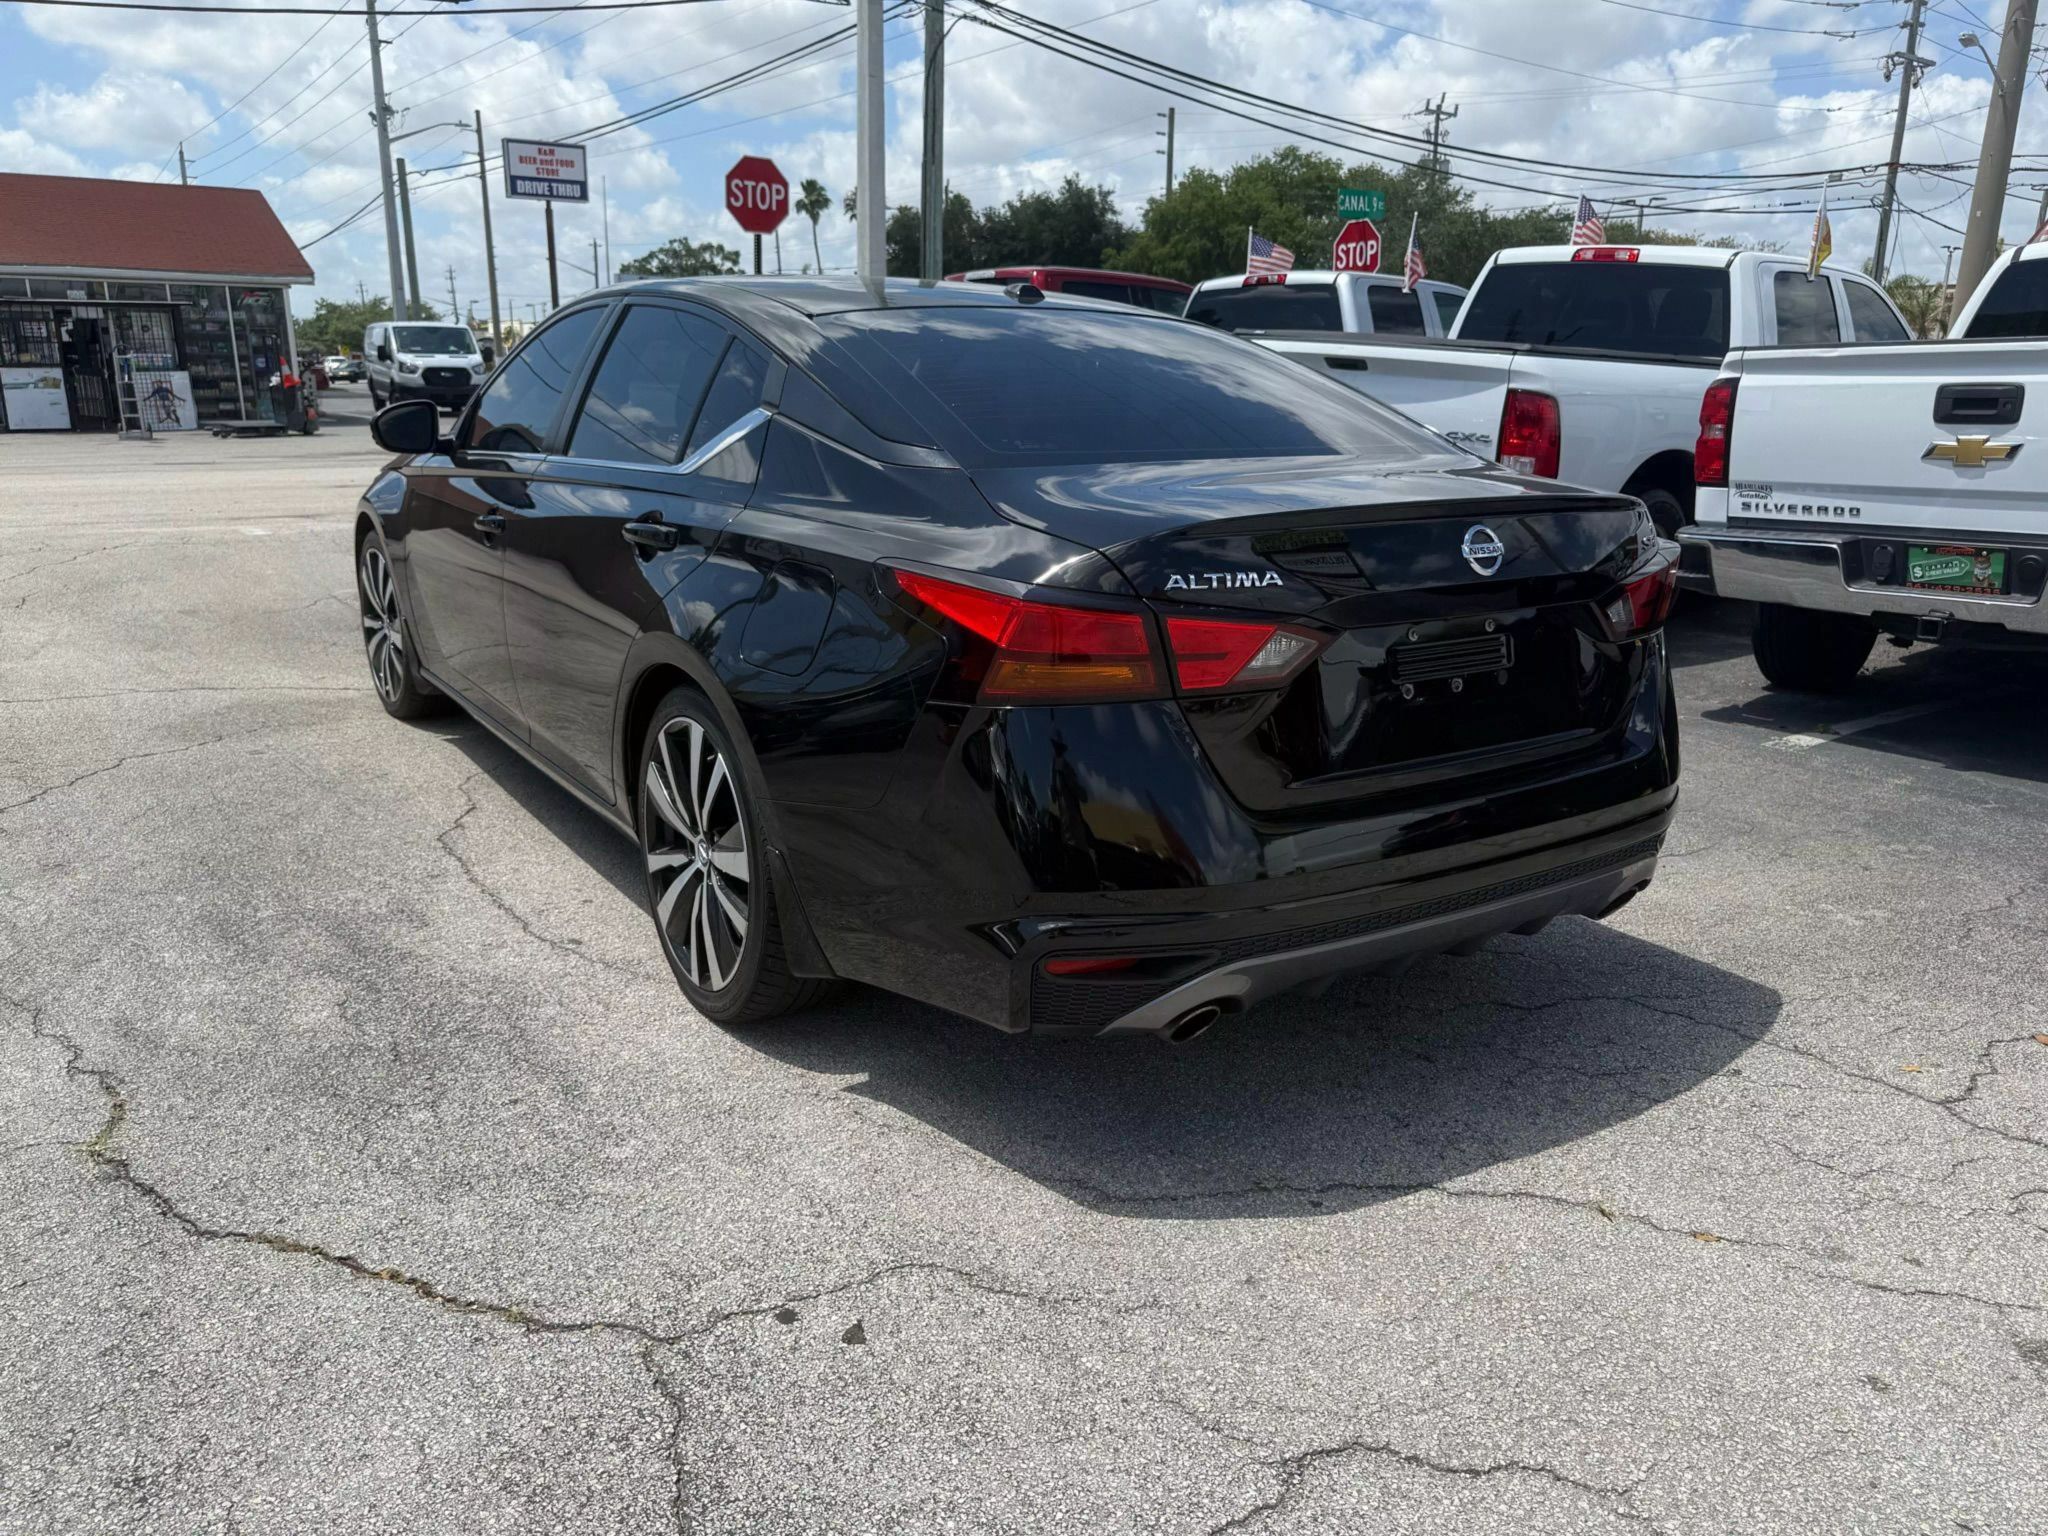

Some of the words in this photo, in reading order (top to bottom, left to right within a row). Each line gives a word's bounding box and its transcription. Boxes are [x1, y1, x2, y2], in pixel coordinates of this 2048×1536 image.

[518, 155, 538, 165] BEER
[555, 159, 576, 169] FOOD
[535, 167, 561, 177] STORE
[516, 179, 551, 195] DRIVE
[551, 183, 581, 198] THRU
[730, 178, 786, 211] STOP
[1338, 195, 1370, 212] CANAL
[1336, 240, 1377, 269] STOP
[1741, 501, 1861, 517] SILVERADO
[1470, 545, 1502, 555] NISSAN
[1163, 570, 1284, 591] ALTIMA
